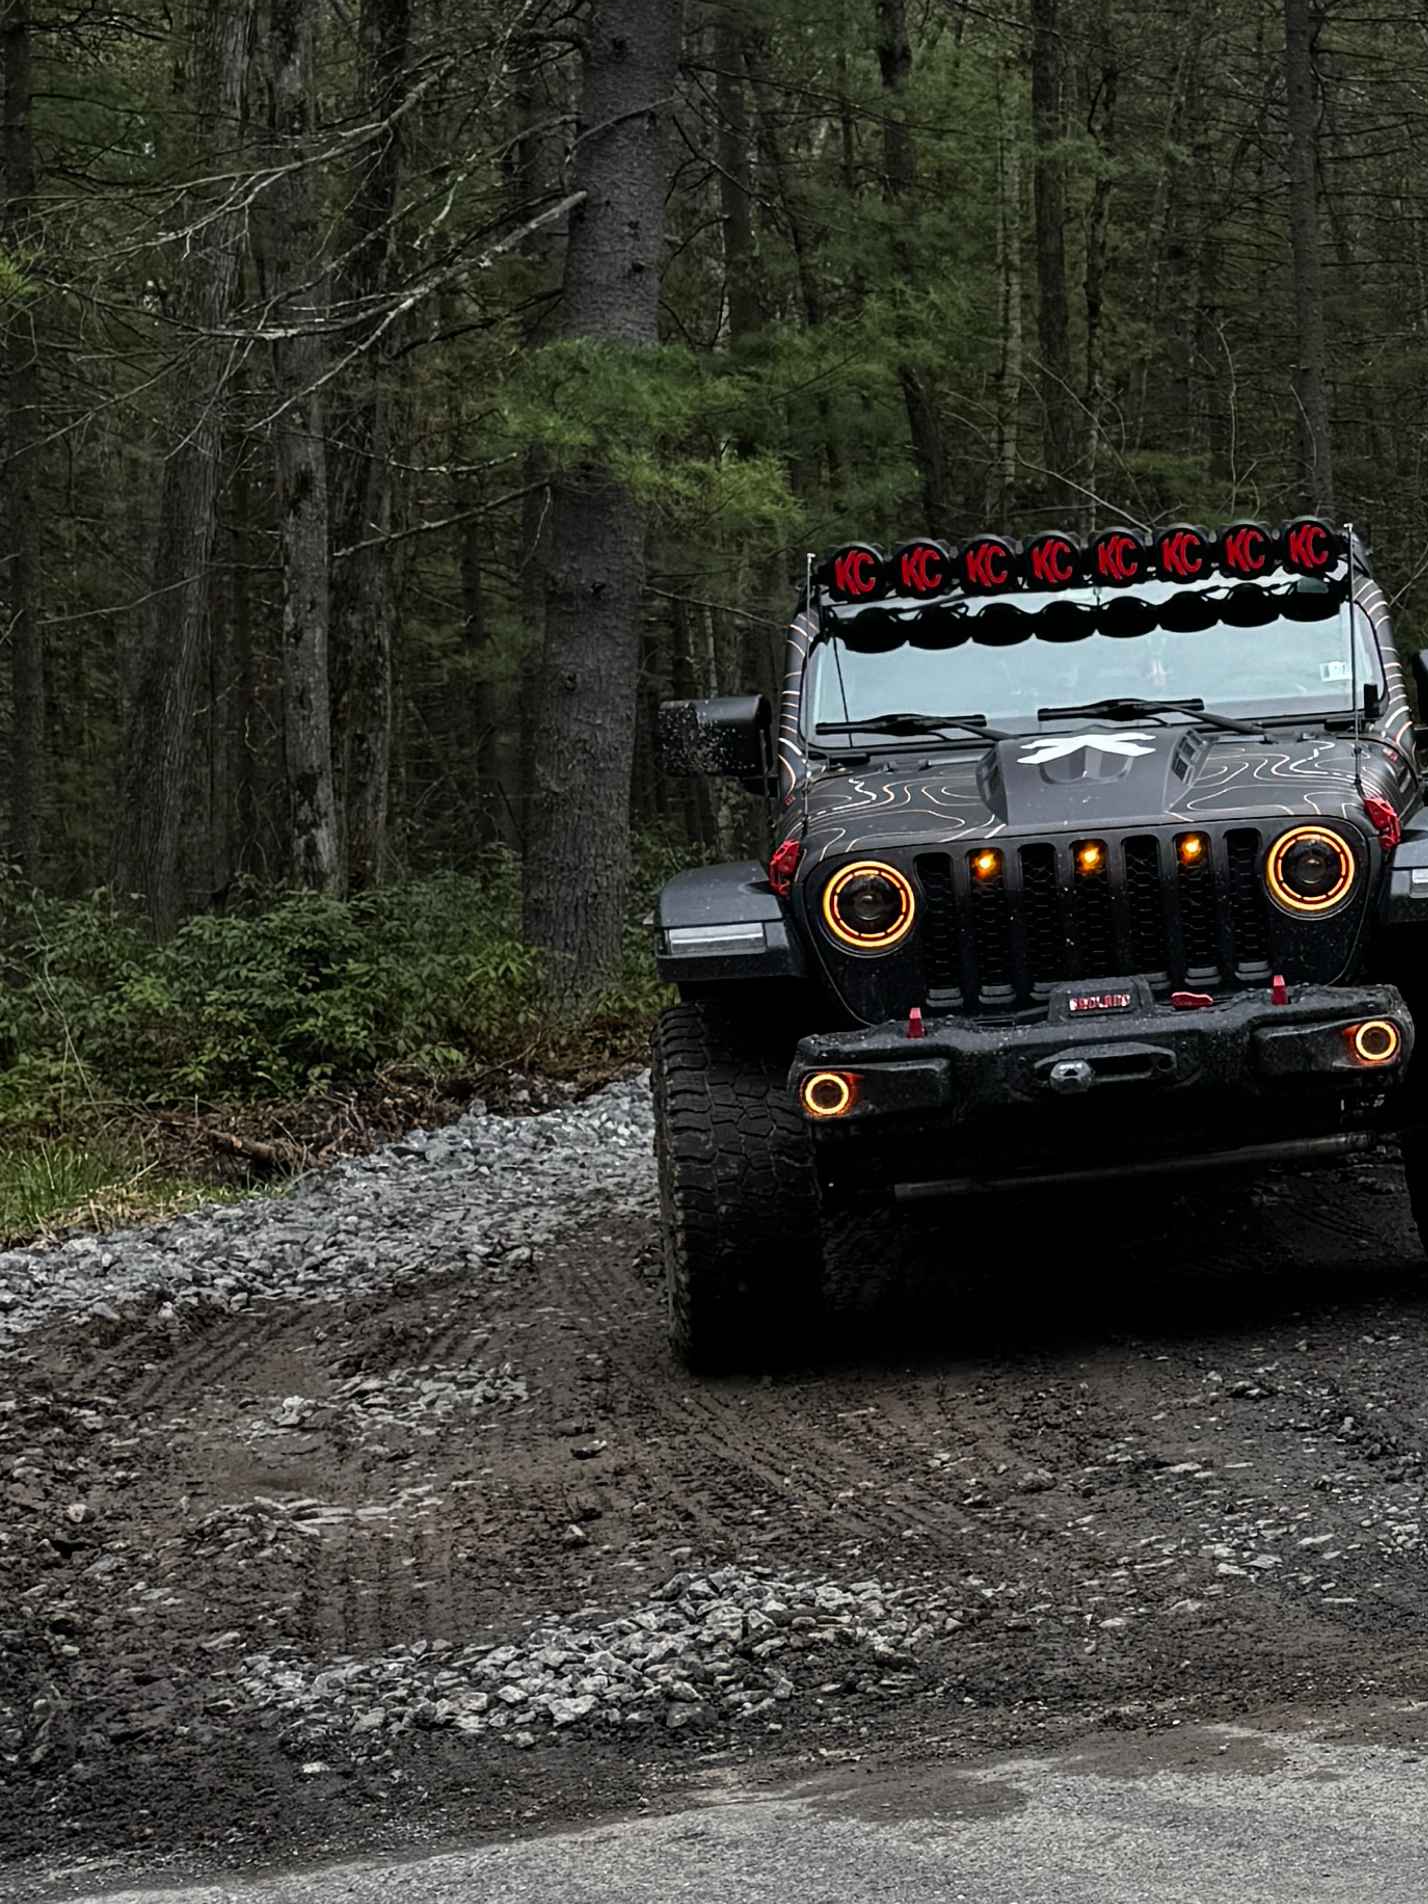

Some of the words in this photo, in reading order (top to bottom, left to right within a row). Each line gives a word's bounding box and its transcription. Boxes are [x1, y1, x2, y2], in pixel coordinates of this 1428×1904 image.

[965, 542, 1008, 586] KC
[1030, 539, 1073, 584] KC
[1097, 533, 1137, 581] KC
[1161, 531, 1202, 577] KC
[1225, 527, 1265, 572] KC
[1288, 523, 1328, 569] KC
[834, 550, 876, 595] KC
[900, 546, 942, 592] KC
